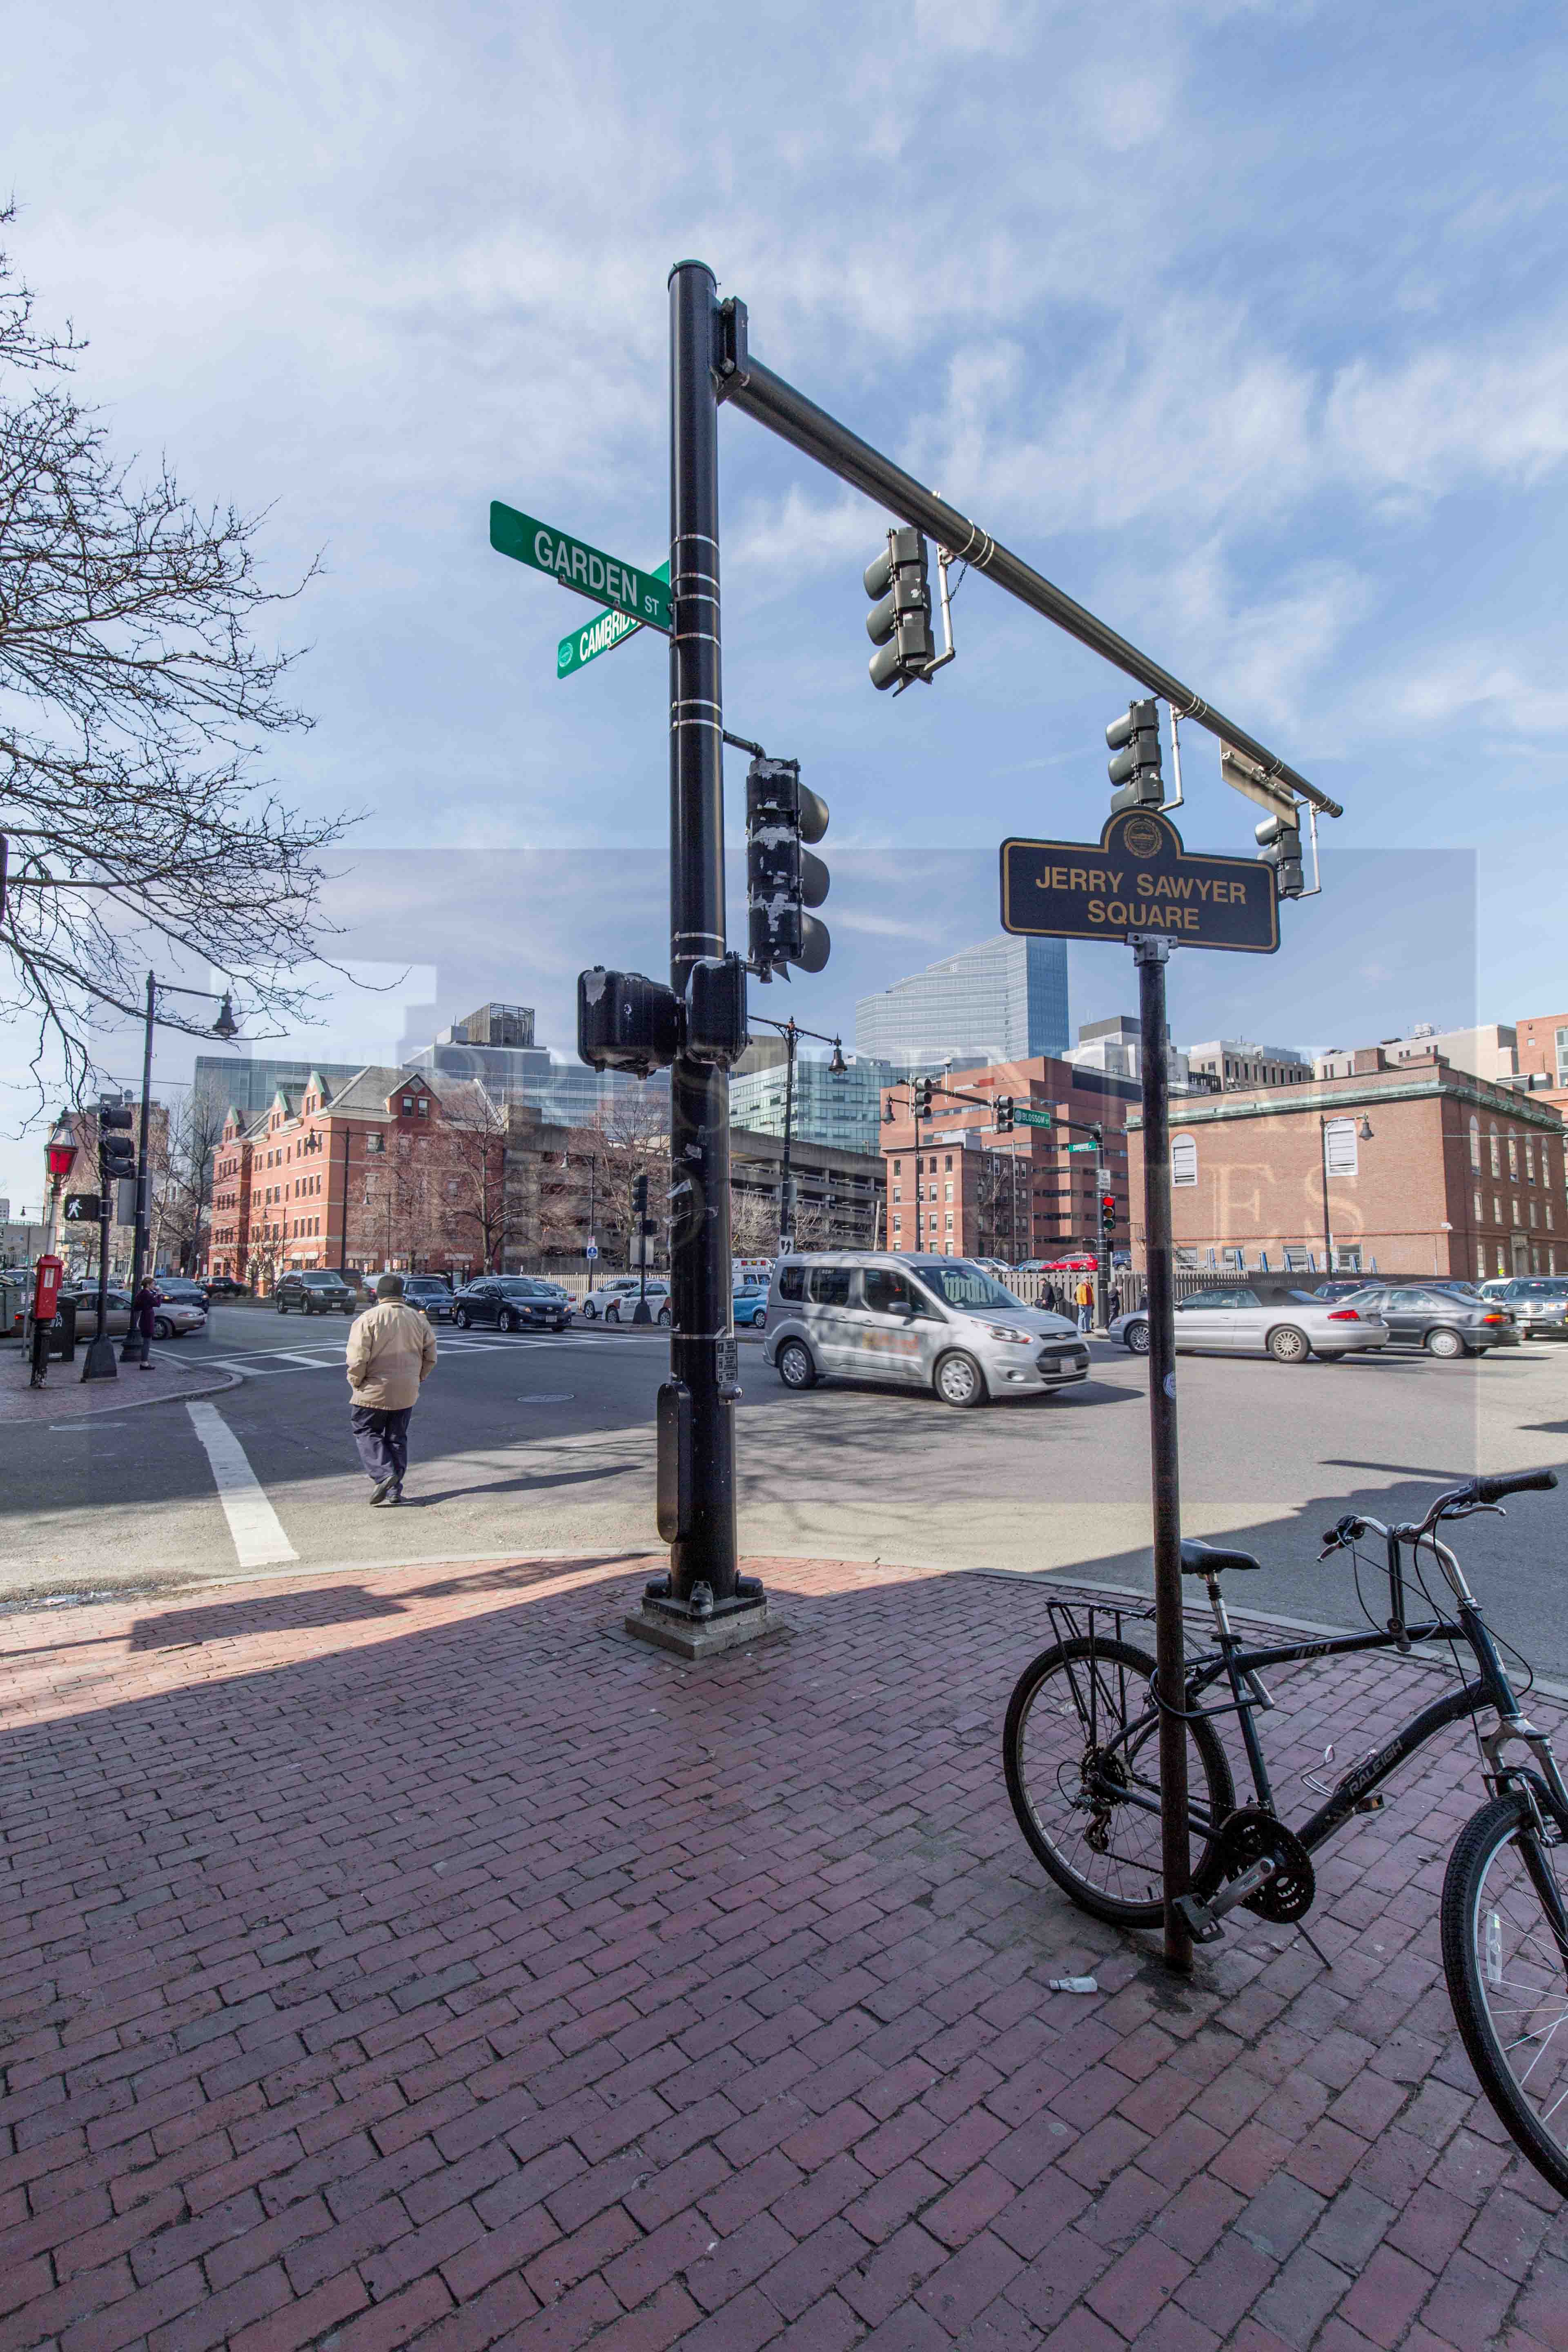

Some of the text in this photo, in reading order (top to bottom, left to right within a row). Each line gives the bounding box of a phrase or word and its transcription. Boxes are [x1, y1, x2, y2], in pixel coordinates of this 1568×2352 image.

[534, 530, 659, 616] GARDEN ST
[579, 610, 642, 662] CAMBRID
[1036, 866, 1247, 904] JERRY SAWYER
[1088, 900, 1200, 930] SQUARE
[1022, 1112, 1045, 1124] BLOSSOM
[1349, 1739, 1403, 1797] RALEIGH
